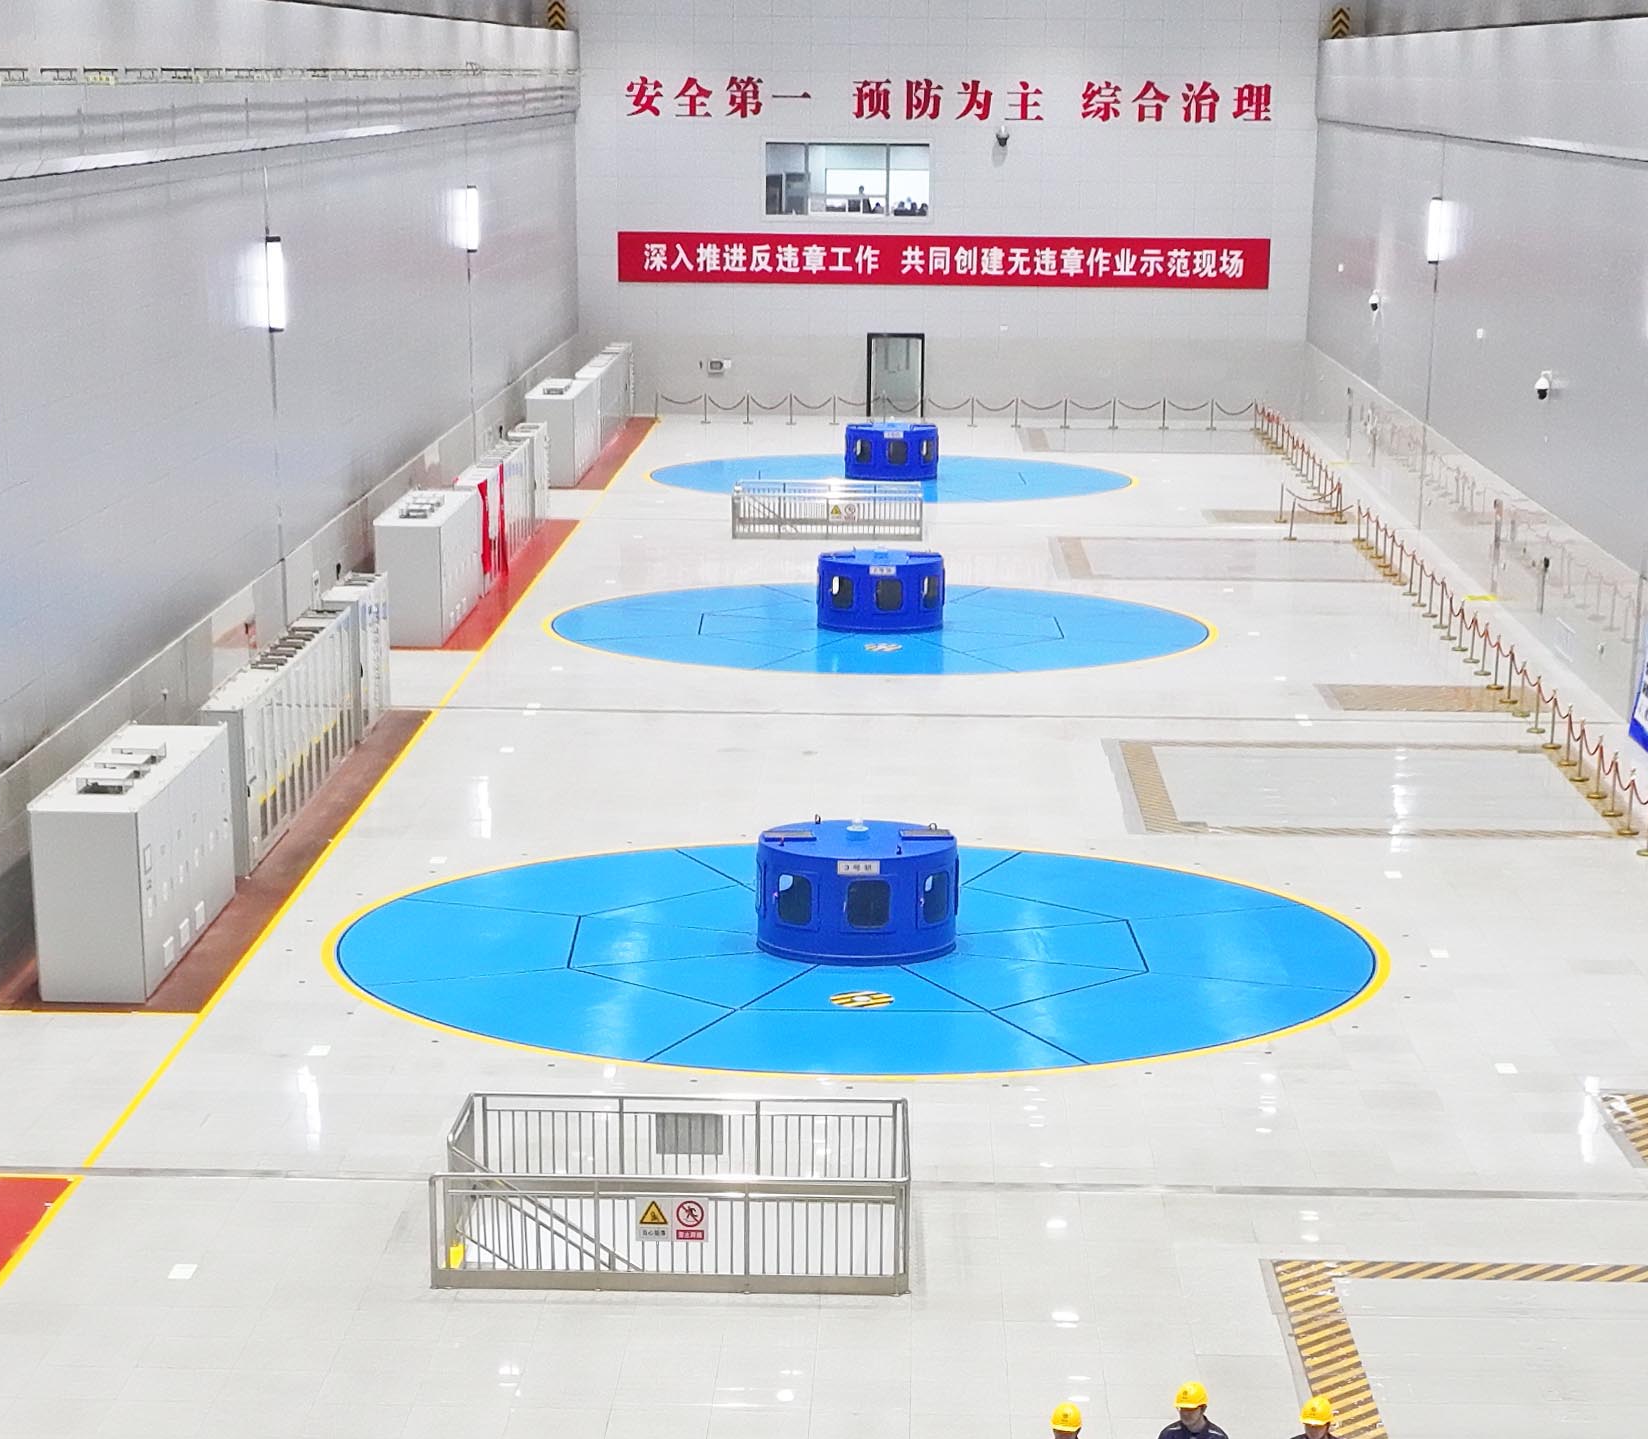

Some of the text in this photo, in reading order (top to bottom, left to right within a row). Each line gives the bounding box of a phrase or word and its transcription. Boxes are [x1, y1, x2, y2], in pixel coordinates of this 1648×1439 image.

[625, 75, 1272, 123] 安全第一 预防为主 综合治理
[644, 243, 1244, 278] 深入推进反违章工作 共同创建无违章作业示范现场
